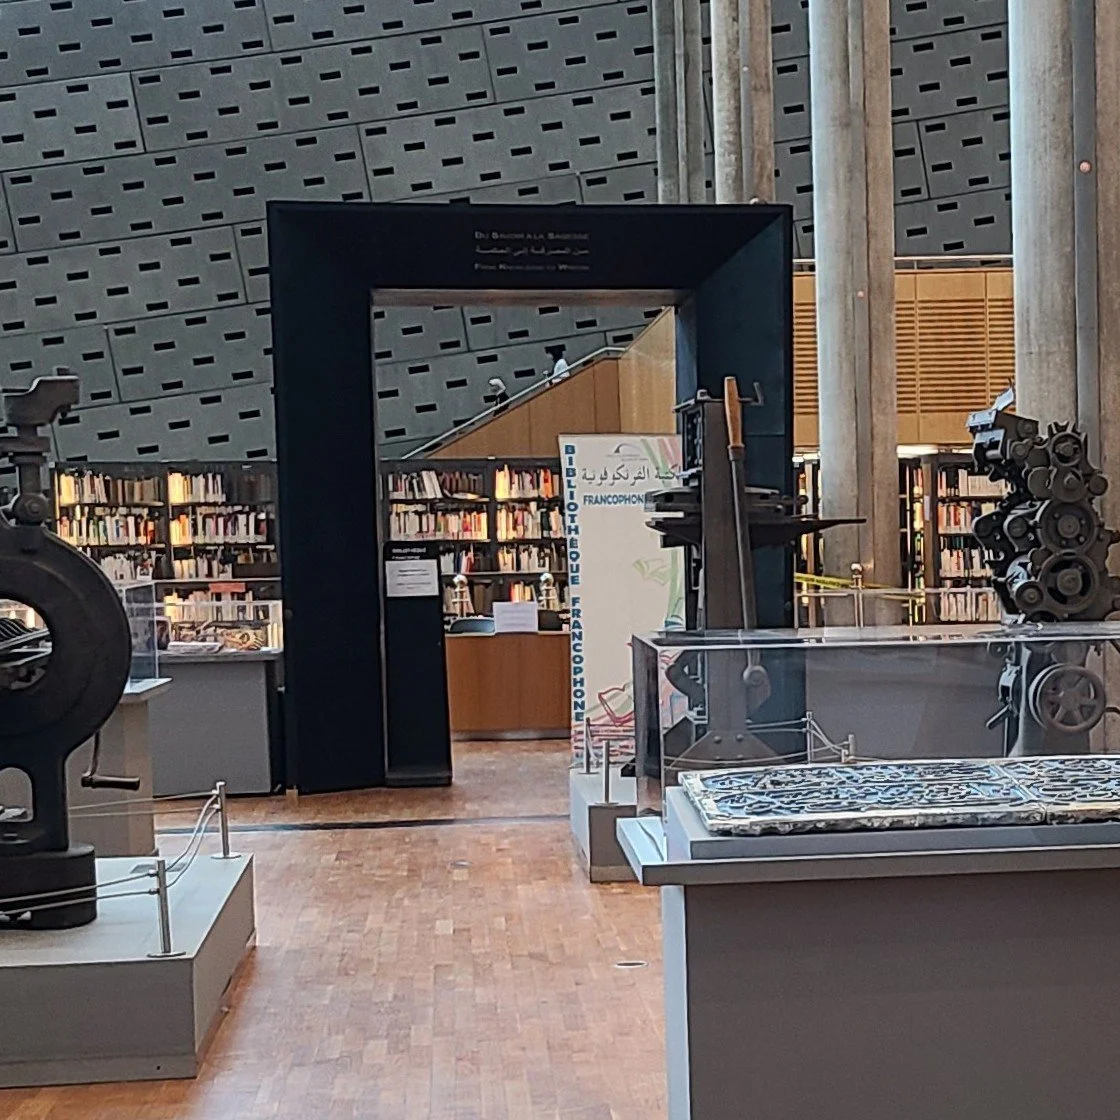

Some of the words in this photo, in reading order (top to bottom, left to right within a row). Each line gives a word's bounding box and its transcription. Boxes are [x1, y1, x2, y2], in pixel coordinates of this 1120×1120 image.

[565, 445, 581, 585] BIBLIOTHÈQUE
[583, 494, 647, 505] FRANCOPHON
[571, 596, 586, 722] FRANCOPHONE
